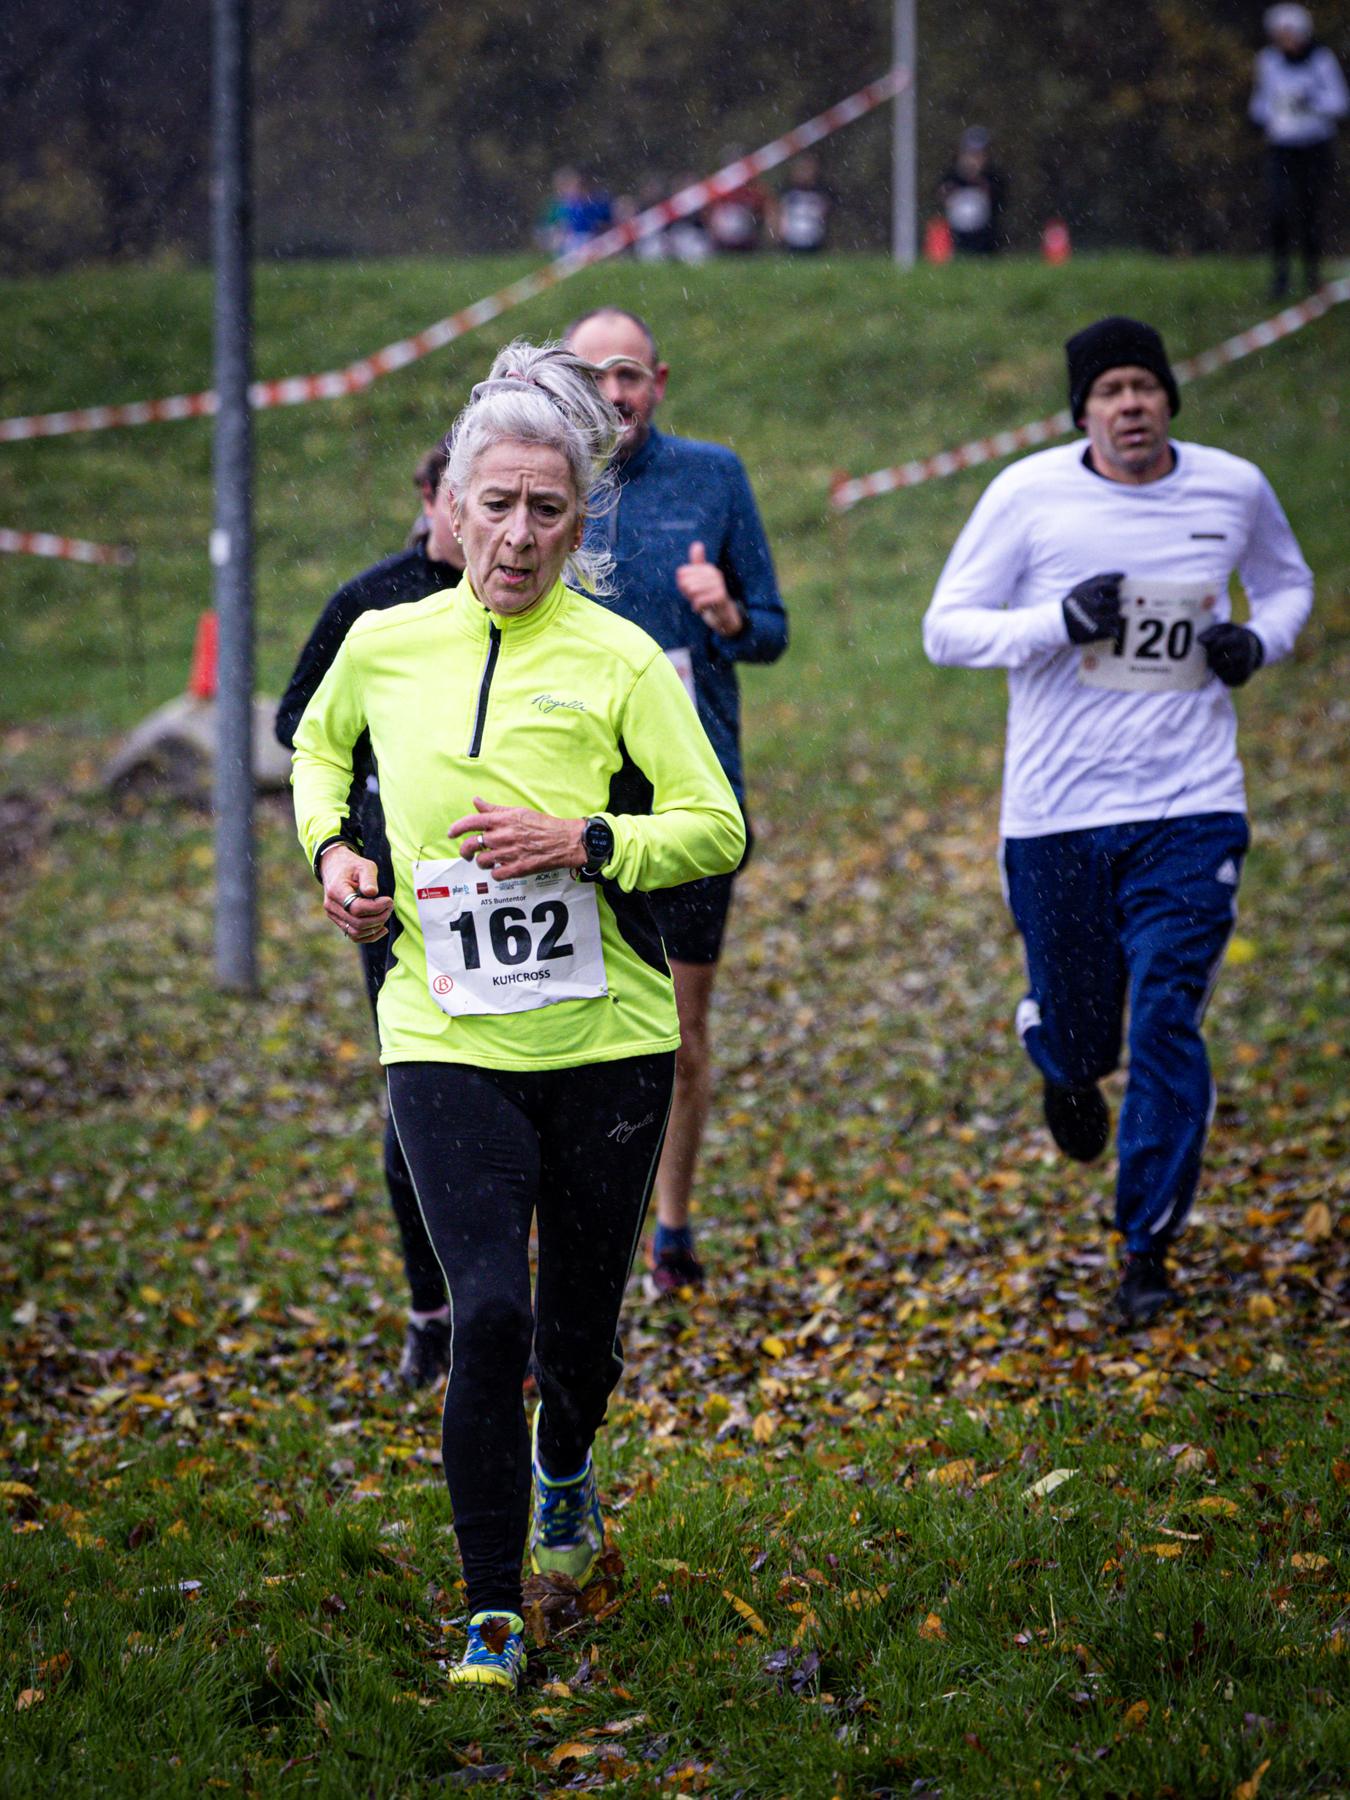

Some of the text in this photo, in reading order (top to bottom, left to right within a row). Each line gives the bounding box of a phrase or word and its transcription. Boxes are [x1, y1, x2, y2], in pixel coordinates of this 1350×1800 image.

[480, 895, 527, 906] ATS Buntentor
[449, 900, 574, 970] 162
[492, 969, 551, 986] KUHCROSS
